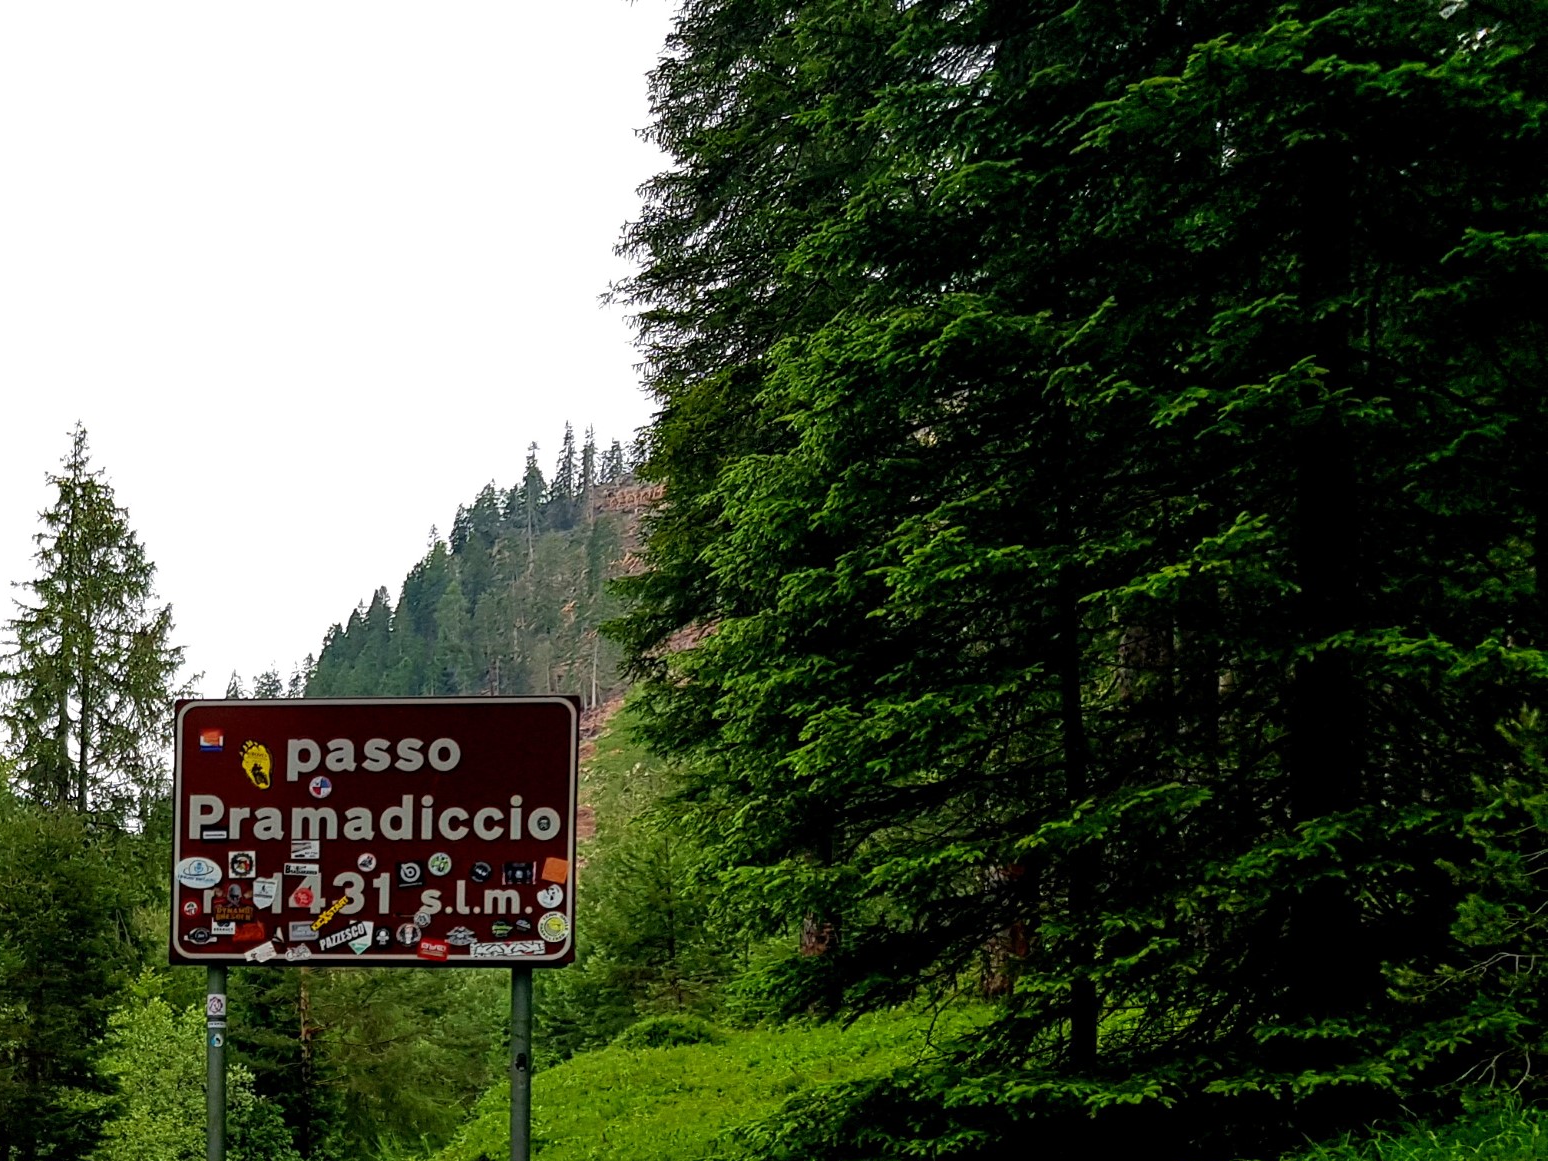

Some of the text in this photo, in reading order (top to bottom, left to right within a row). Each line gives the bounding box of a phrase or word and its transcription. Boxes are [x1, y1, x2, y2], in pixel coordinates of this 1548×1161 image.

[286, 738, 462, 781] passo
[188, 795, 561, 840] Pramadiccio
[271, 872, 534, 916] 1431 s.l.m.
[319, 923, 365, 951] PAZZESCO
